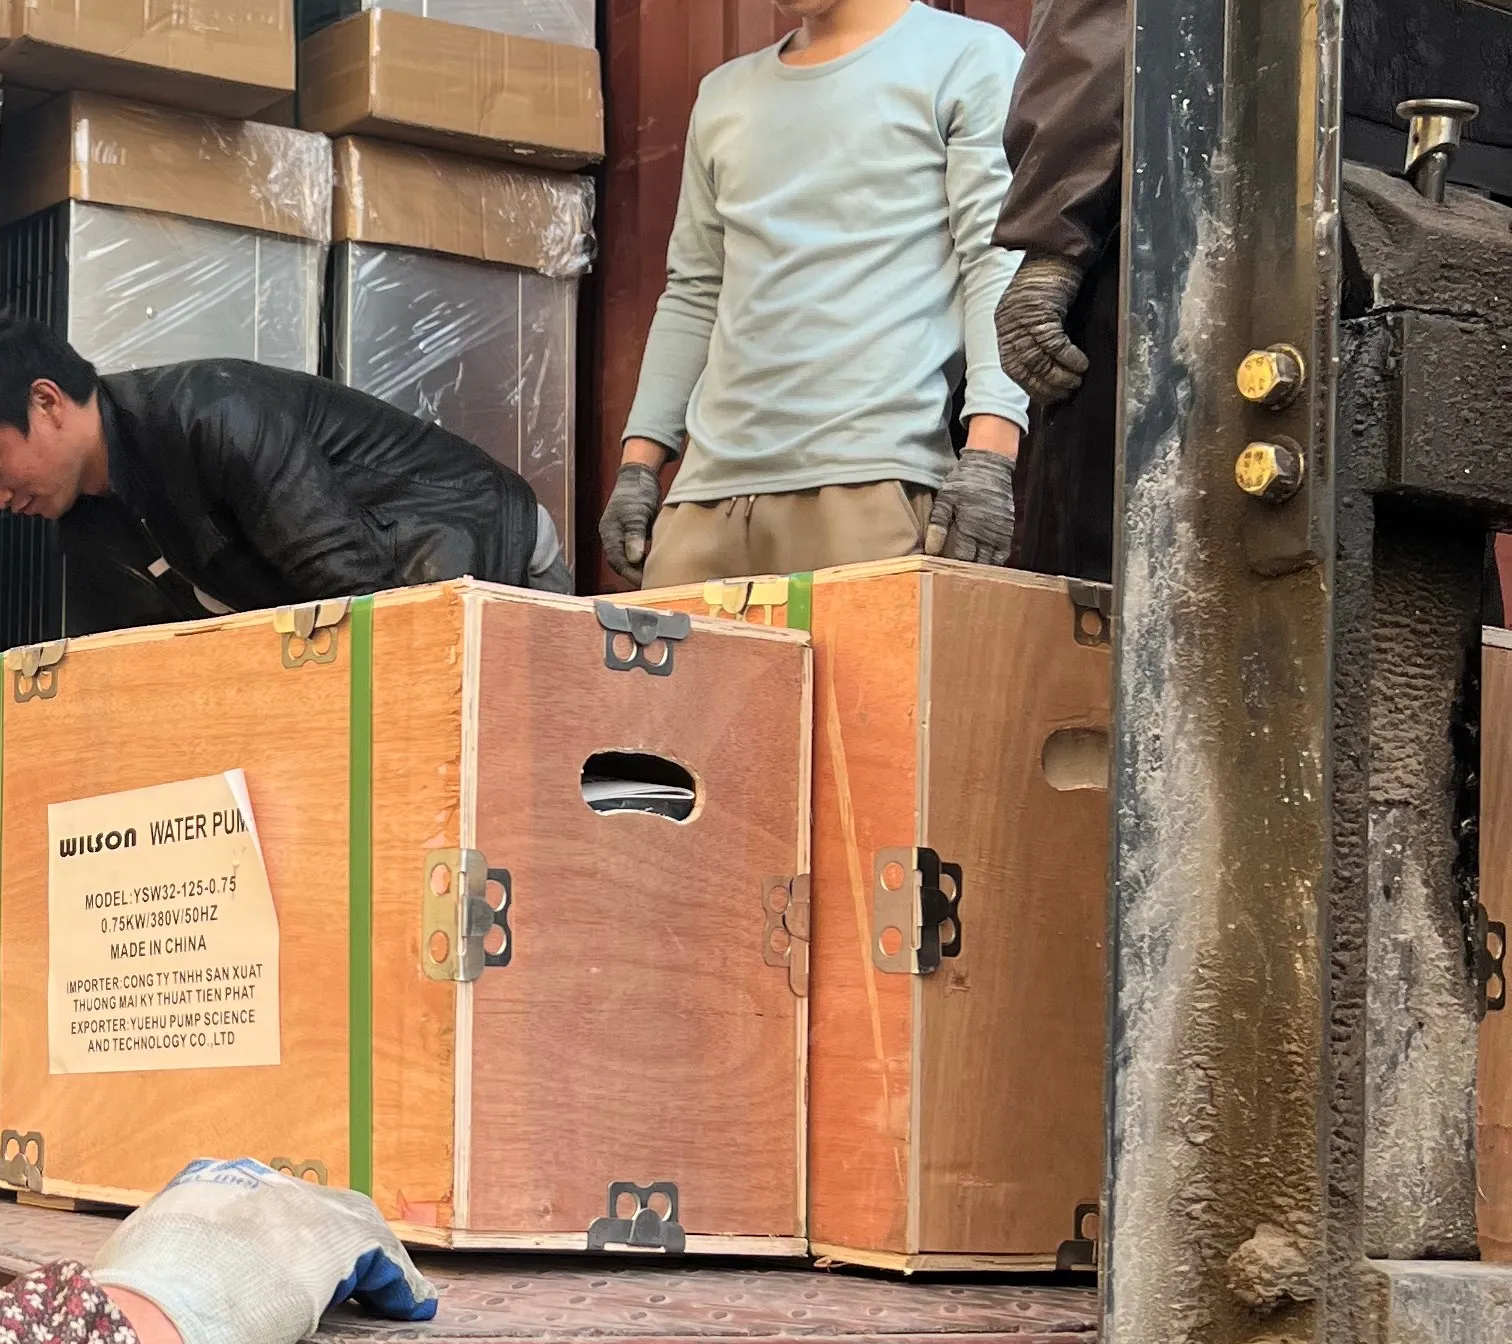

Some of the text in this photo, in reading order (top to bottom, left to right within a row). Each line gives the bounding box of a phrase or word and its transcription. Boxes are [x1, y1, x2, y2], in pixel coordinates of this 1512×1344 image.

[149, 813, 207, 846] WATER
[85, 875, 237, 911] MODEL:YSW32-125-0.75
[100, 904, 219, 934] 0.75KW/380V/50HZ
[110, 934, 207, 960] MADE IN CHINA
[156, 971, 170, 986] TY
[173, 968, 203, 985] TNHH
[205, 966, 230, 982] SAN
[232, 963, 263, 979] XUAT
[73, 985, 255, 1013] THUONG MAI KY THUAT TIEN PHAT
[71, 1009, 256, 1035] EXPORTER:YUEHU PUMP SCIENCE
[87, 1038, 110, 1053] AND
[112, 1033, 188, 1051] TECHNOLOGY
